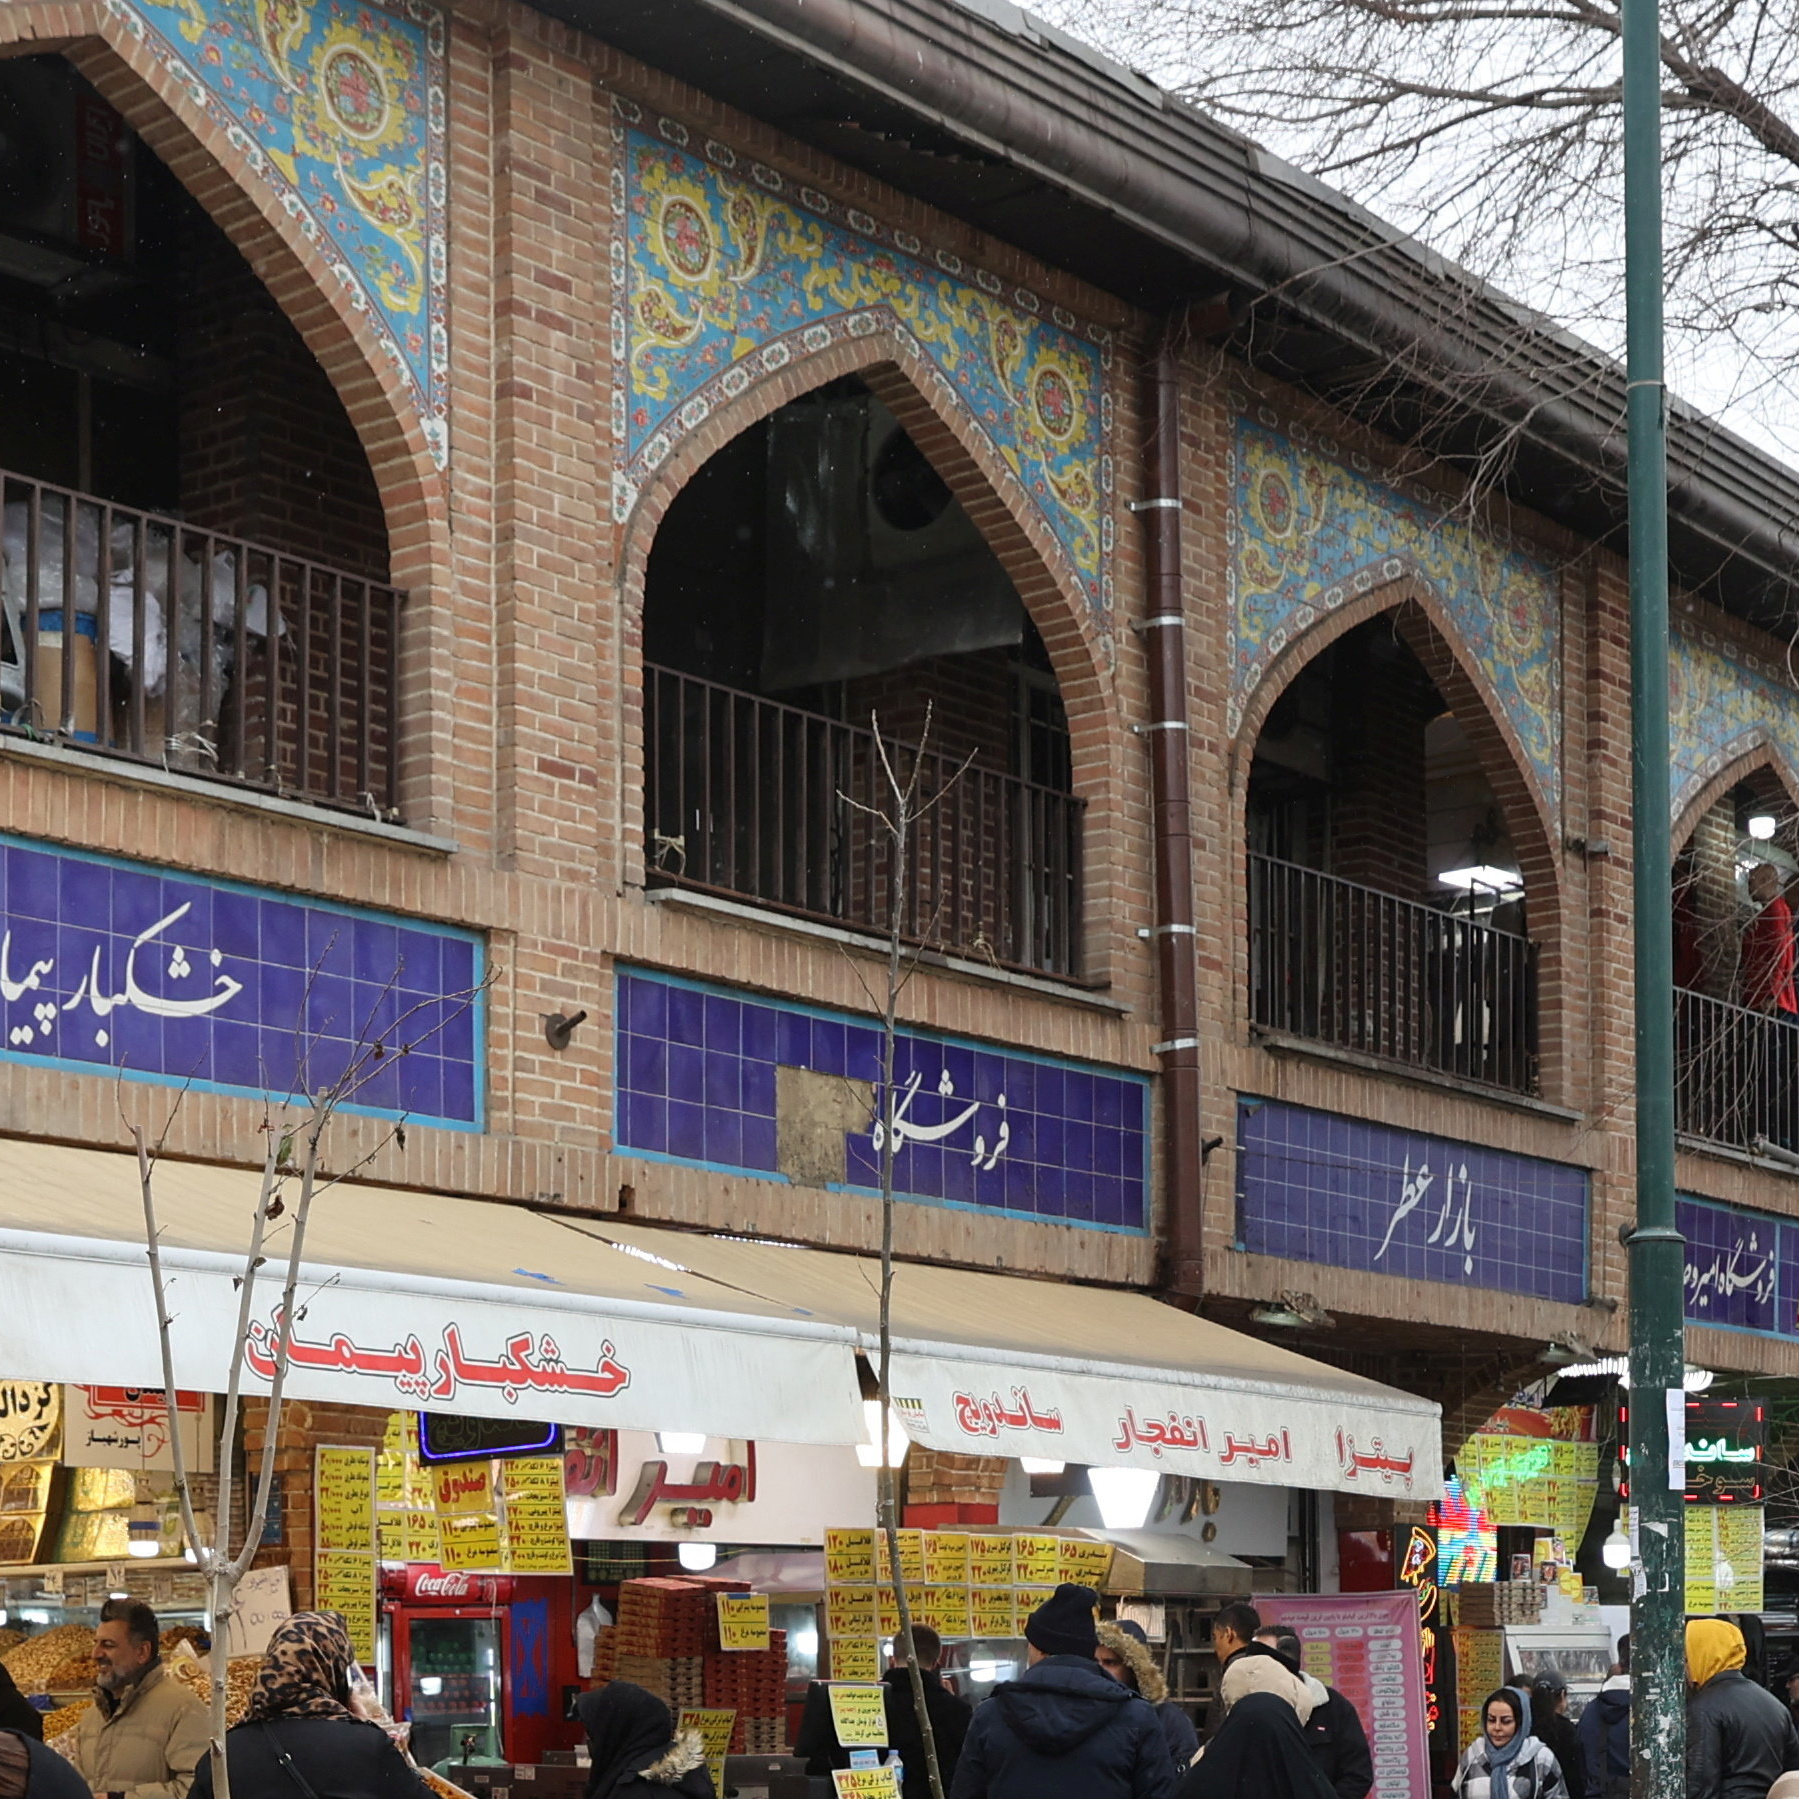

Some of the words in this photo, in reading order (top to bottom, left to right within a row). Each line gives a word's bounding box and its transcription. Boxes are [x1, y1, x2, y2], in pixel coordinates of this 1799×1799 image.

[61, 900, 244, 1048] خشکبار
[872, 1068, 1010, 1171] فروشگاه
[1373, 1153, 1435, 1261] عطر
[1427, 1162, 1477, 1275] بازار
[1718, 1230, 1776, 1305] فروشگاه
[243, 1302, 431, 1401] پیمان
[430, 1320, 632, 1405] خشکبار
[952, 1384, 1065, 1438] ساندویچ
[1111, 1402, 1210, 1460] انفجار
[1219, 1425, 1292, 1469] امیر
[1334, 1424, 1416, 1491] پیتزا
[438, 1468, 487, 1504] صندوق
[618, 1440, 756, 1529] امیر
[406, 1514, 427, 1529] ۱۶۵
[970, 1539, 986, 1555] ۱۷۵
[1016, 1539, 1035, 1556] ۱۶۵
[444, 1547, 461, 1563] ۱۱۰
[1059, 1542, 1078, 1558] ۱۶۵
[722, 1600, 735, 1615] ۱۱۰
[723, 1625, 737, 1641] ۱۱۰
